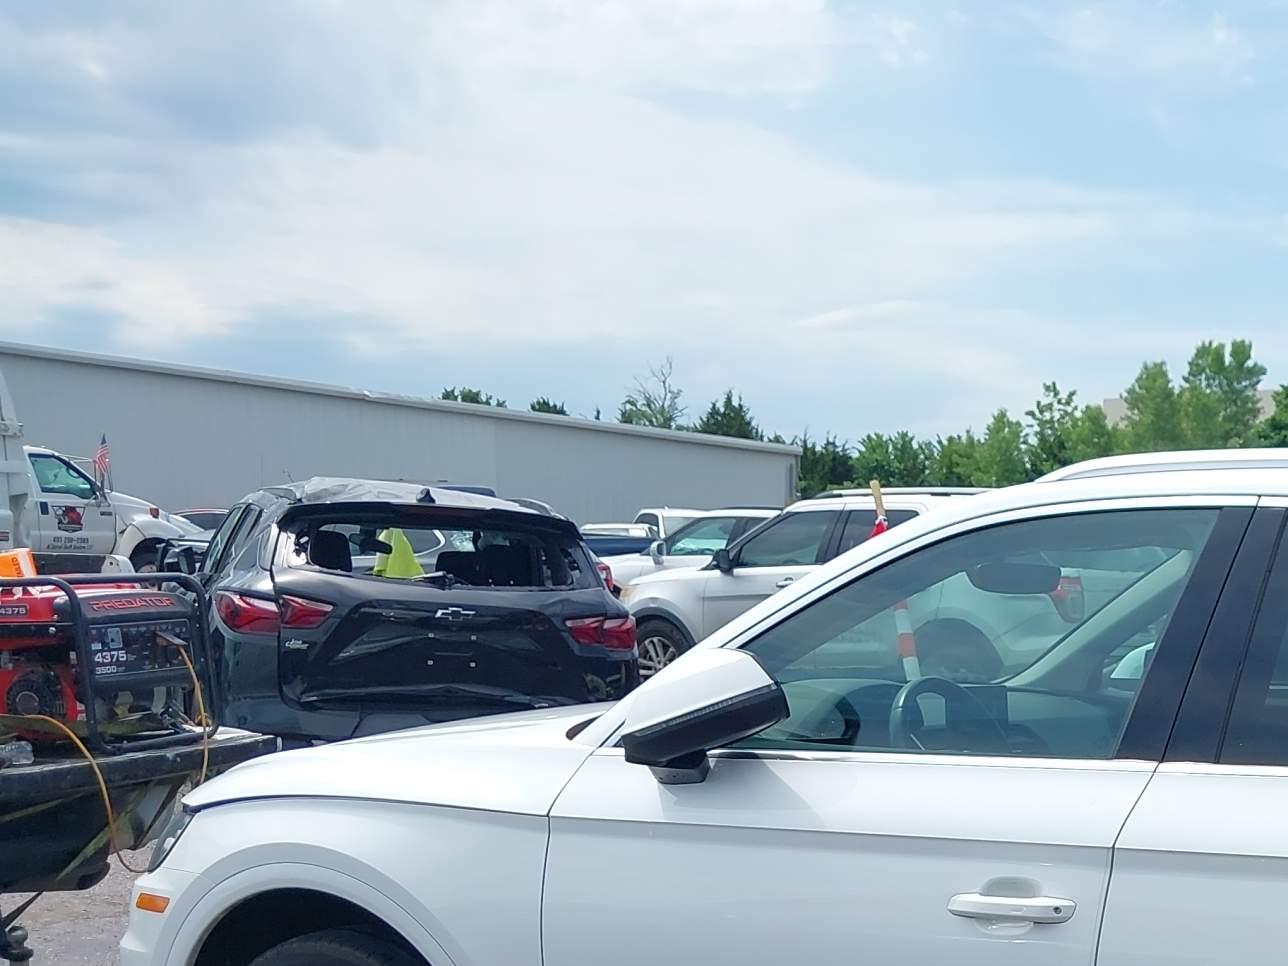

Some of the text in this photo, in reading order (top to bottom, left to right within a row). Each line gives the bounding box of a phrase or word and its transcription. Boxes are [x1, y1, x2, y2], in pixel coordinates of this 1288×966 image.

[88, 597, 176, 611] PREDATOR
[94, 650, 127, 663] 4375
[95, 665, 117, 674] 3500
